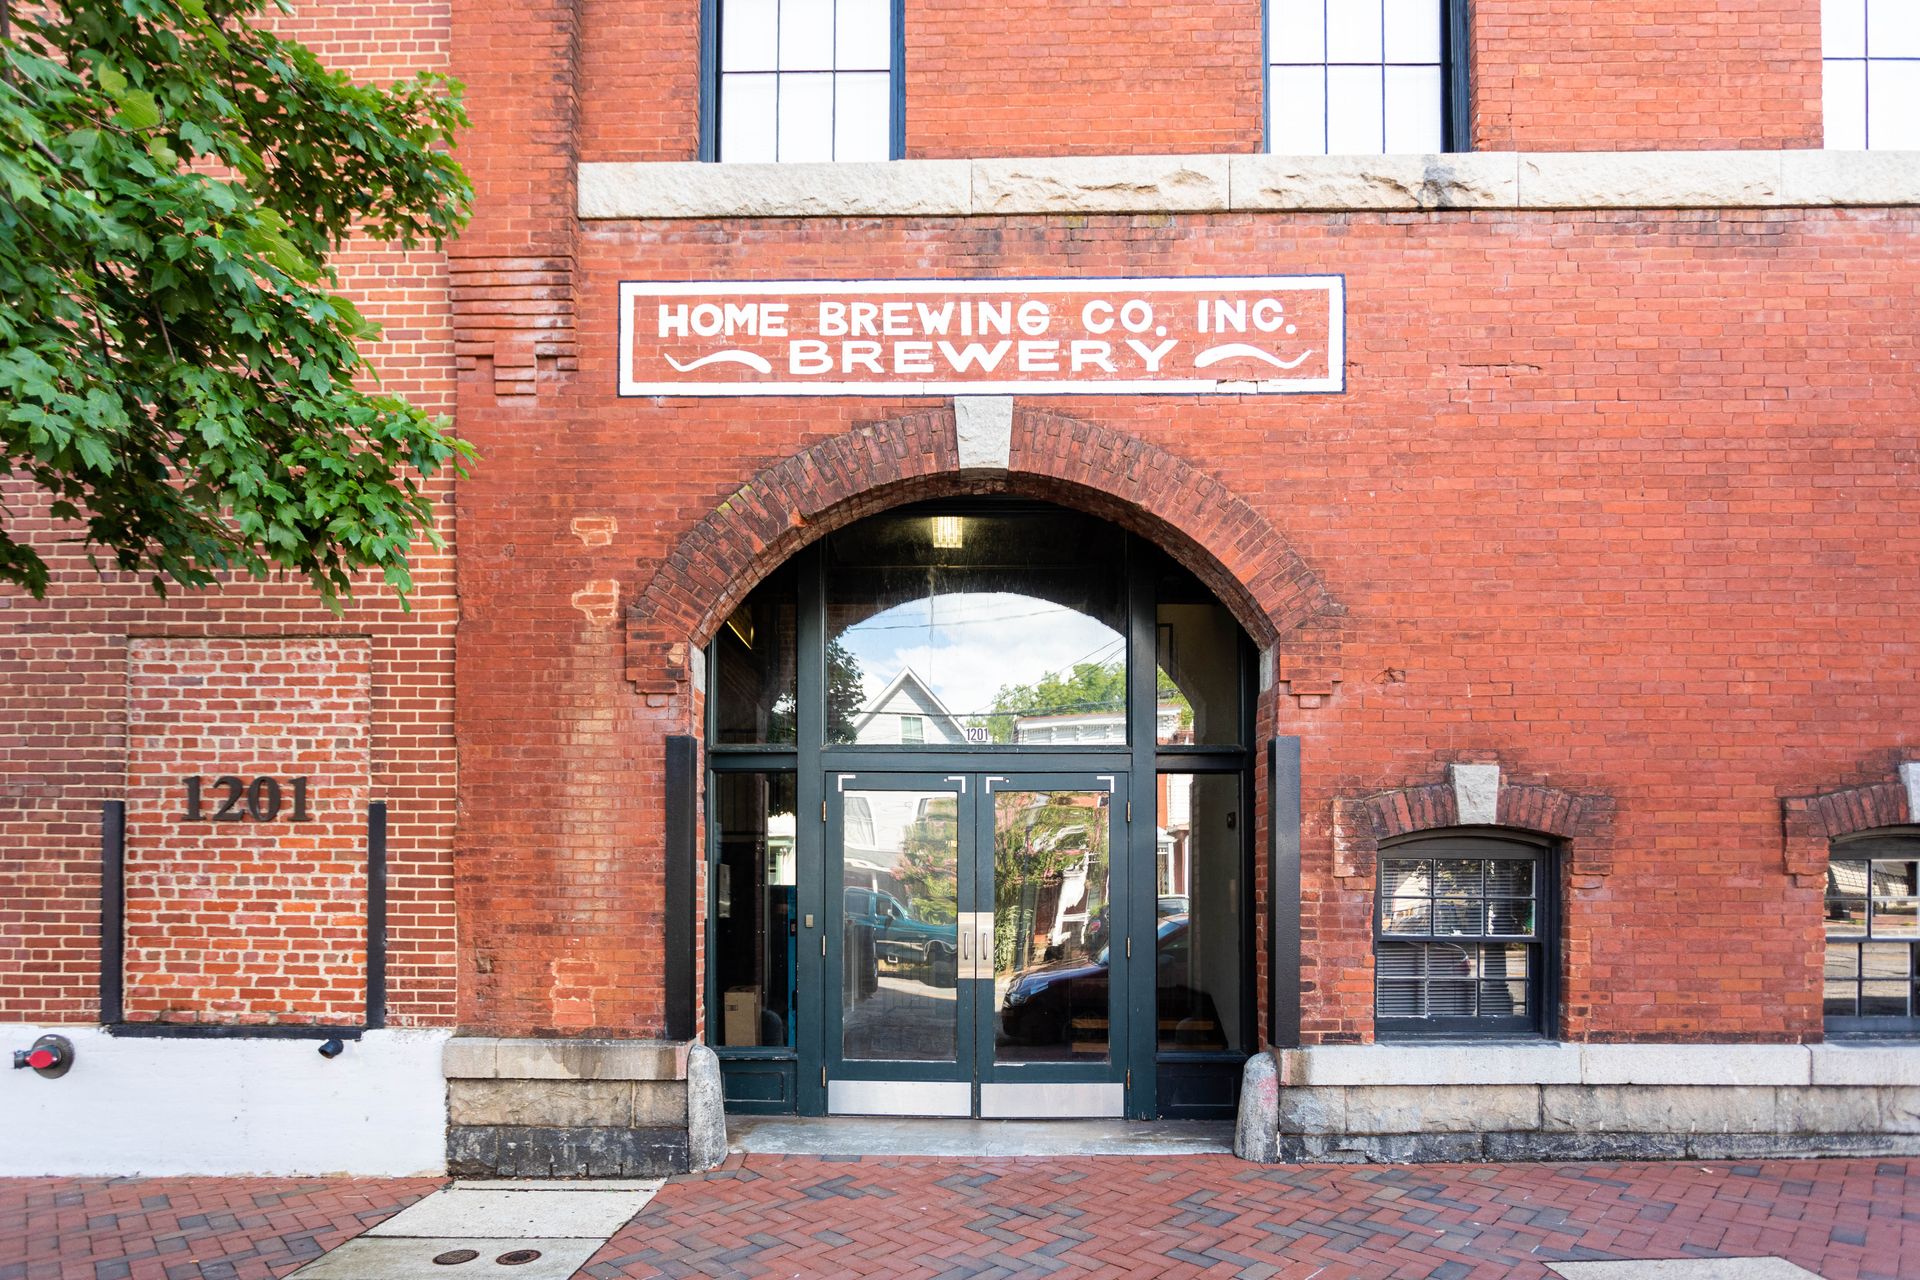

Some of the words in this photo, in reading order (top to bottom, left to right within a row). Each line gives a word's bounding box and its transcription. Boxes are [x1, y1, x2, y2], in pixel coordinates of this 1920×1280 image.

[658, 303, 789, 338] HOME
[819, 301, 1050, 337] BREWING
[1081, 299, 1167, 337] CO.
[1198, 298, 1297, 335] INC.
[788, 339, 1180, 375] BREWERY
[966, 727, 988, 741] 1201
[180, 775, 314, 823] 1201
